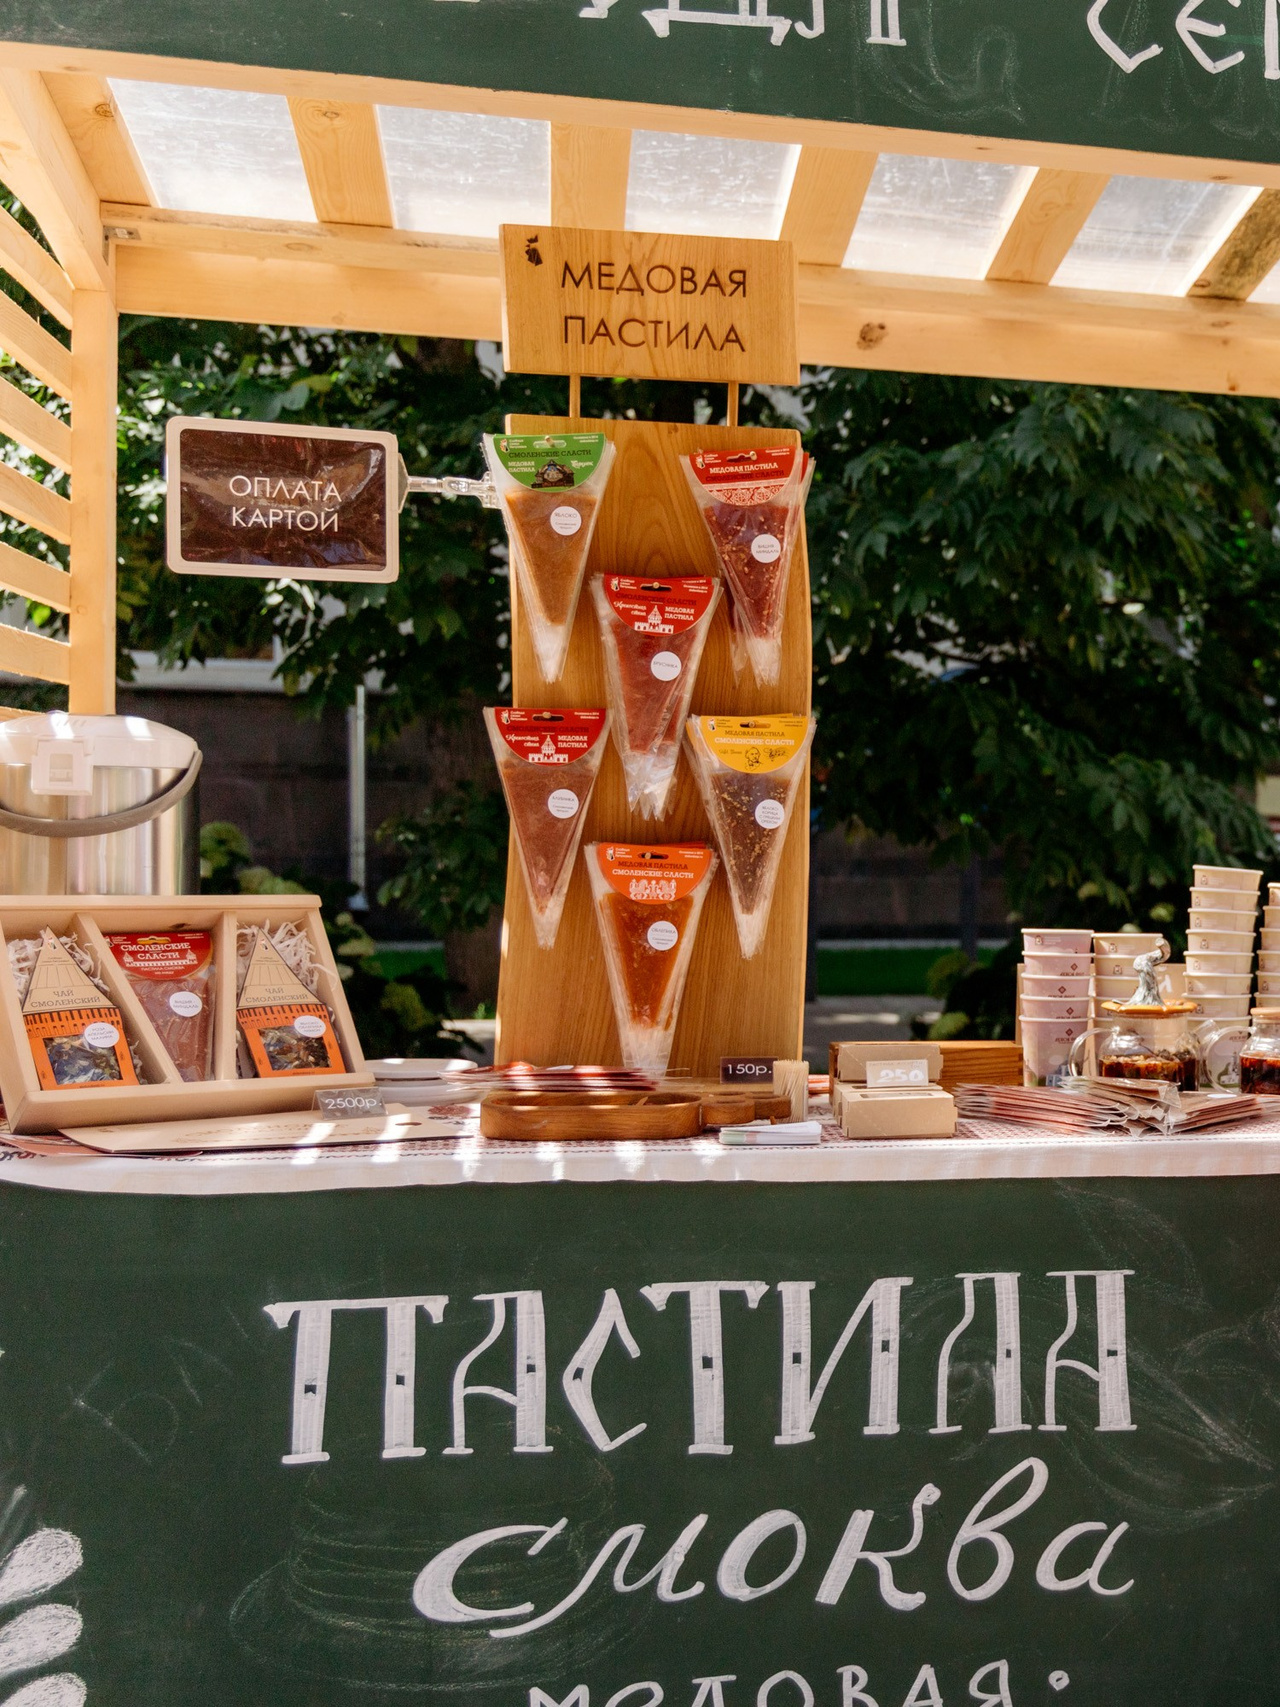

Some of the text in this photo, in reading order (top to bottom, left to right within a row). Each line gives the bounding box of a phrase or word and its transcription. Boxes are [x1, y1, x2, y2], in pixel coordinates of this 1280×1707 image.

[560, 260, 748, 299] МЕДОВАЯ
[562, 315, 746, 353] ПАСТИЛА
[508, 449, 592, 459] СМОЛЕНСКИЕ СЛАСТИ
[708, 462, 778, 474] МЕДОВАЯ ПАСТИЛА
[229, 474, 342, 506] ОПЛАТА
[230, 499, 340, 533] КАРТОЙ
[617, 861, 653, 869] МЕДОВАЯ
[612, 869, 694, 879] СМОЛЕНСКИЕ СЛАСТИ
[121, 943, 191, 951] СМОЛЕНСКИЕ
[138, 952, 180, 960] СЛАСТИ
[53, 989, 75, 997] ЧАЙ
[245, 994, 309, 1003] СМОЛЕНСКИЙ
[31, 996, 101, 1008] СМОЛЕНСКИЙ
[726, 1062, 773, 1076] 150р.
[877, 1069, 925, 1083] 250
[325, 1096, 383, 1111] 2500р.
[262, 1269, 1138, 1464] ПАСТИЛА
